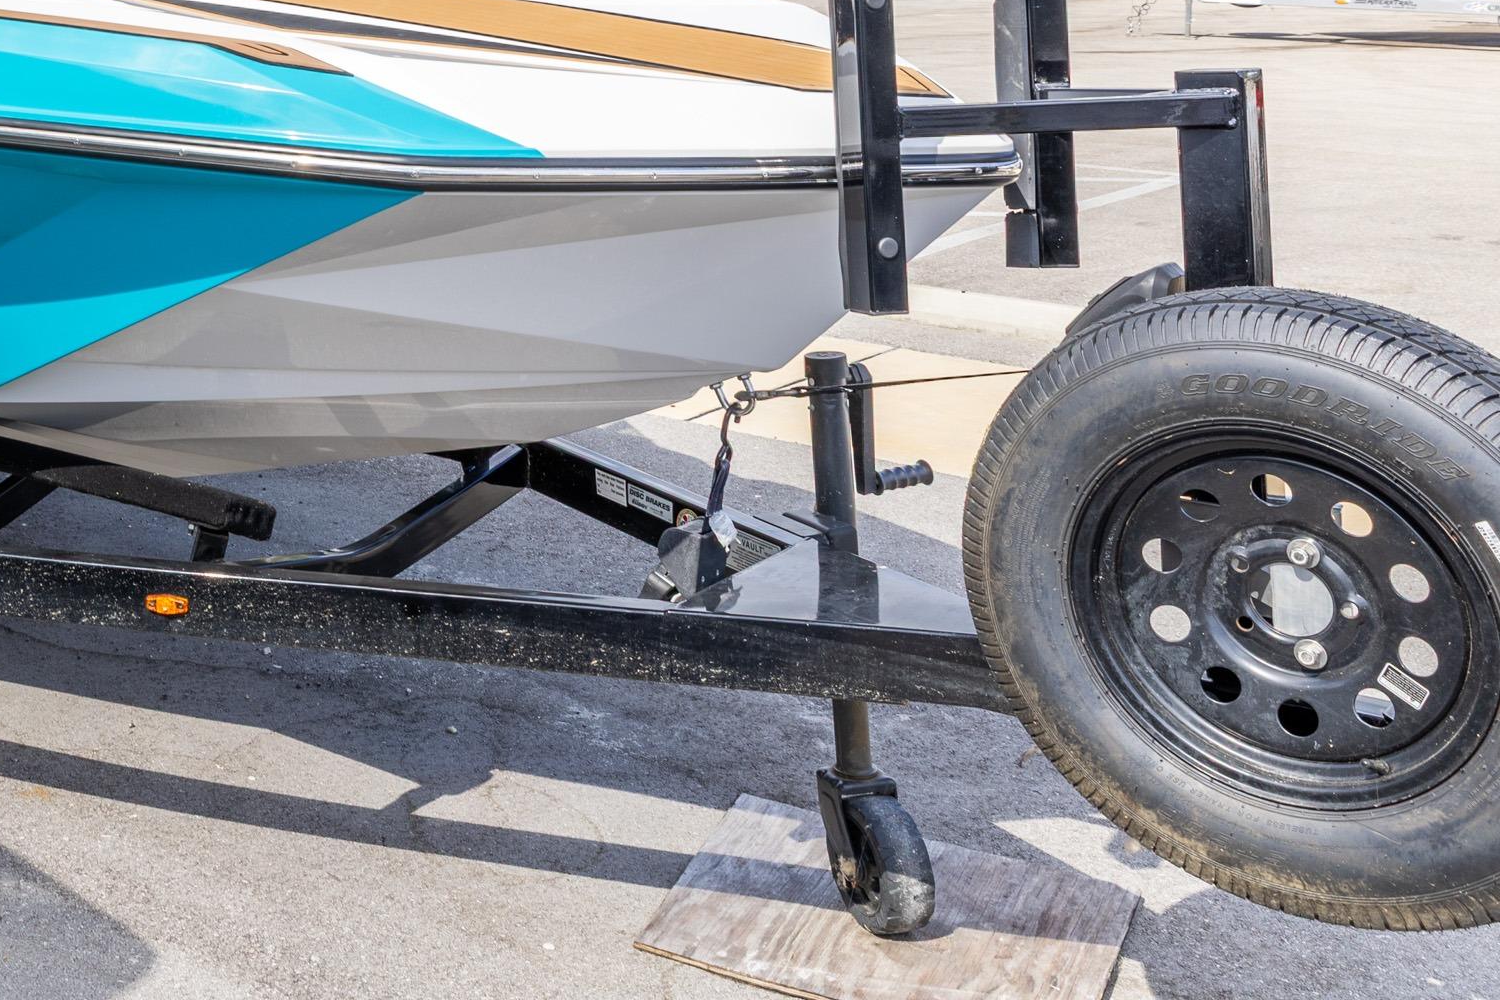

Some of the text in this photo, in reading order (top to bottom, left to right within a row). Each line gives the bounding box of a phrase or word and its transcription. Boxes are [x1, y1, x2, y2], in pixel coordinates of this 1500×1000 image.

[1179, 372, 1471, 482] GOODRIDE
[629, 488, 645, 500] DISC
[645, 494, 671, 512] BRAKES
[741, 538, 762, 553] VAULT
